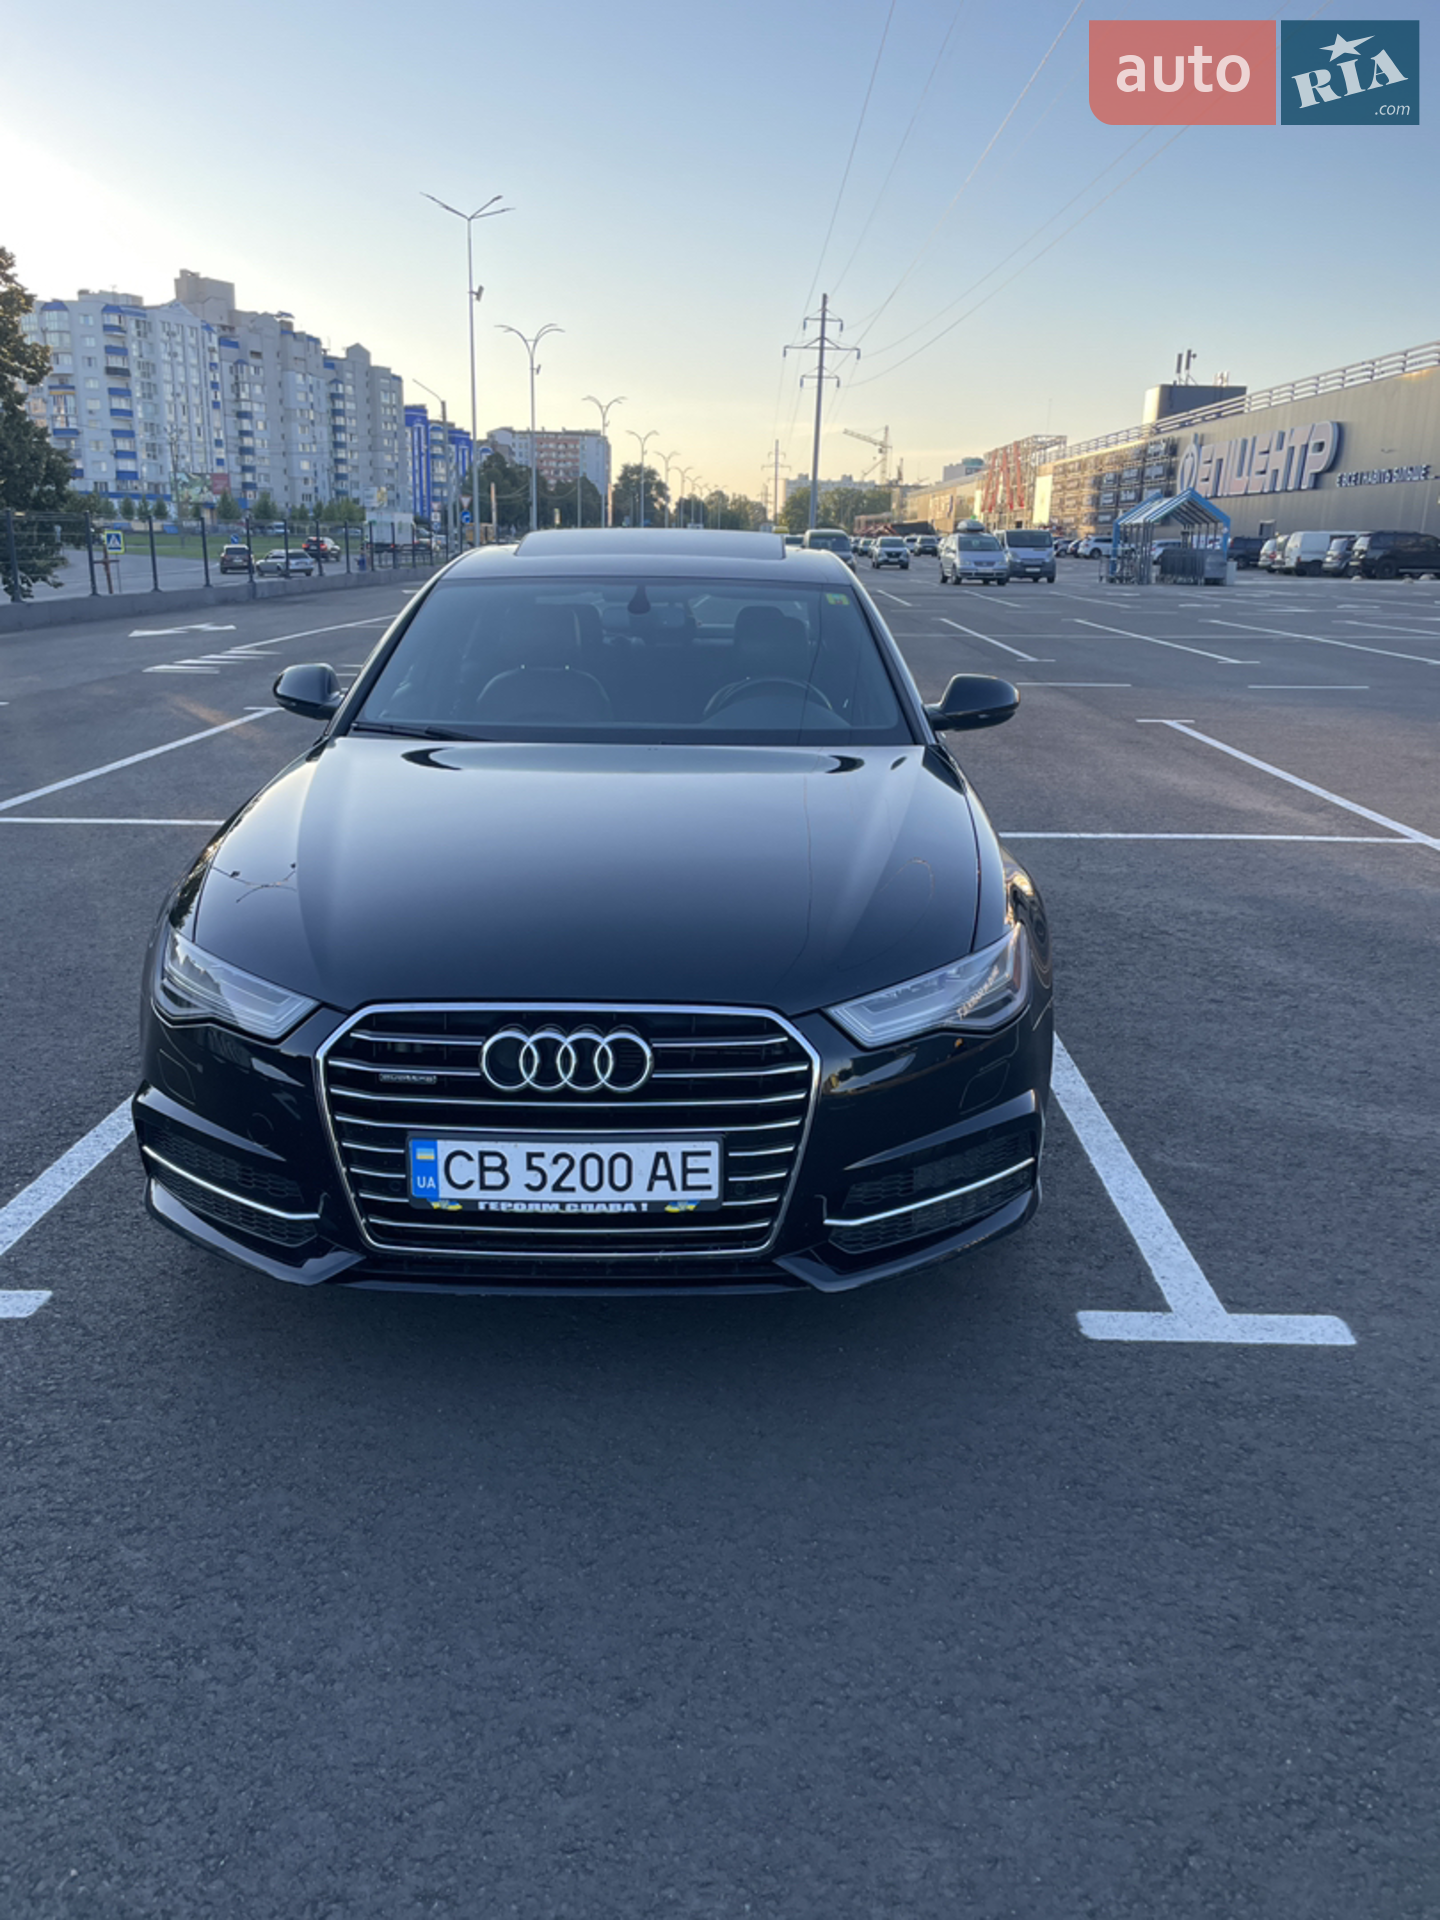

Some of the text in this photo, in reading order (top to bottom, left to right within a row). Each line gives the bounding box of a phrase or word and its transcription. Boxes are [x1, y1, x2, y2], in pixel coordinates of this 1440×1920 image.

[416, 1175, 436, 1189] UA
[443, 1149, 713, 1193] CB 5200 AE
